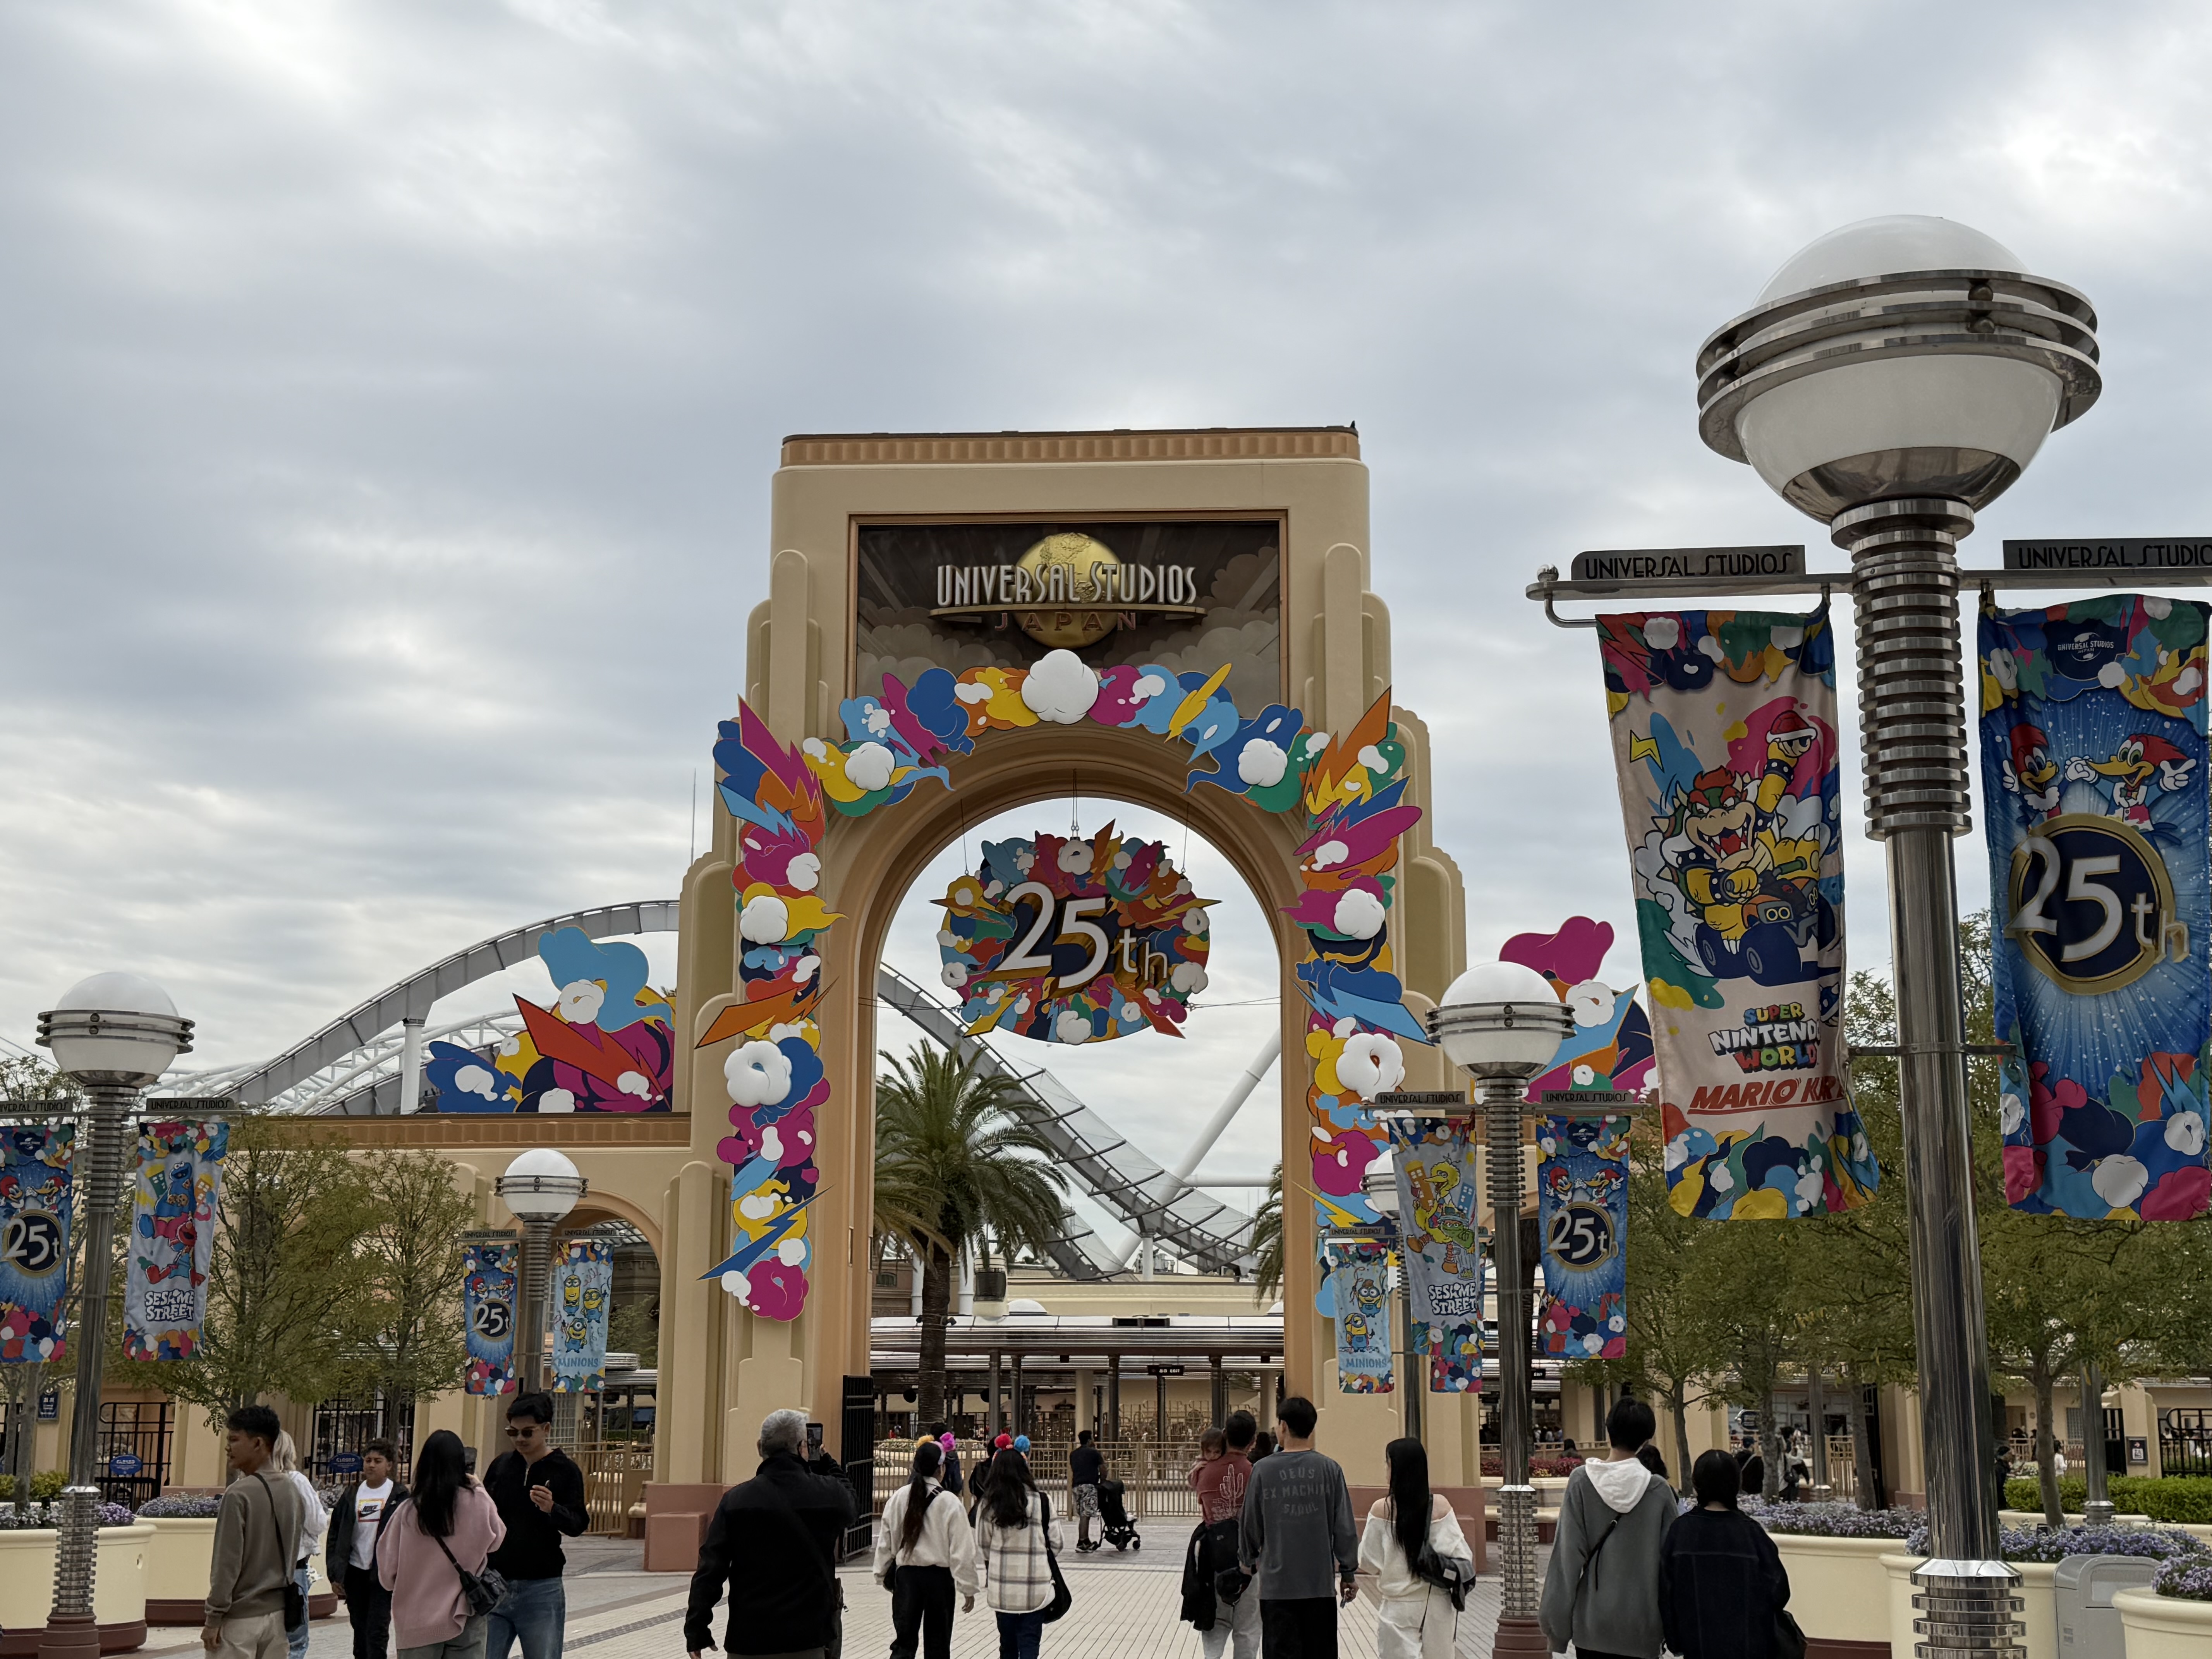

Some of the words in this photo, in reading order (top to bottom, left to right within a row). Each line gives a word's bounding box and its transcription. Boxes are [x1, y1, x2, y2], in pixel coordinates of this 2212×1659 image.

[2018, 545, 2133, 569] UNIVERSAL
[1585, 555, 1695, 580] UNIVERSAL
[1700, 553, 1793, 576] STUDIOS
[937, 563, 1081, 607] UNIVERSAL
[1091, 561, 1197, 606] STUDIOS
[995, 611, 1136, 631] JAPAN
[2057, 641, 2089, 651] UNIVERSAL
[2090, 640, 2114, 649] STUDIOS
[2003, 834, 2190, 964] 25th
[990, 881, 1169, 992] 25th
[1743, 1001, 1806, 1026] SUPER
[1734, 1042, 1818, 1073] WORLD
[1380, 1094, 1423, 1104] UNIVERSAL
[1424, 1094, 1461, 1103] STUDIOS
[1546, 1093, 1589, 1102] UNIVERSAL
[1591, 1093, 1628, 1102] STUDIOS
[1689, 1078, 1798, 1110] MARIO
[33, 1102, 69, 1111] STUDIOS
[151, 1100, 193, 1110] UNIVERSAL
[195, 1099, 230, 1109] STUDIOS
[145, 1289, 194, 1307] SESAME
[1428, 1282, 1476, 1300] SESAME
[146, 1304, 194, 1322] STREET
[1431, 1297, 1476, 1316] STREET
[558, 1357, 599, 1368] MINIONS
[1346, 1358, 1387, 1368] MINIONS
[1279, 1467, 1315, 1481] DEUS
[1263, 1486, 1277, 1499] EX
